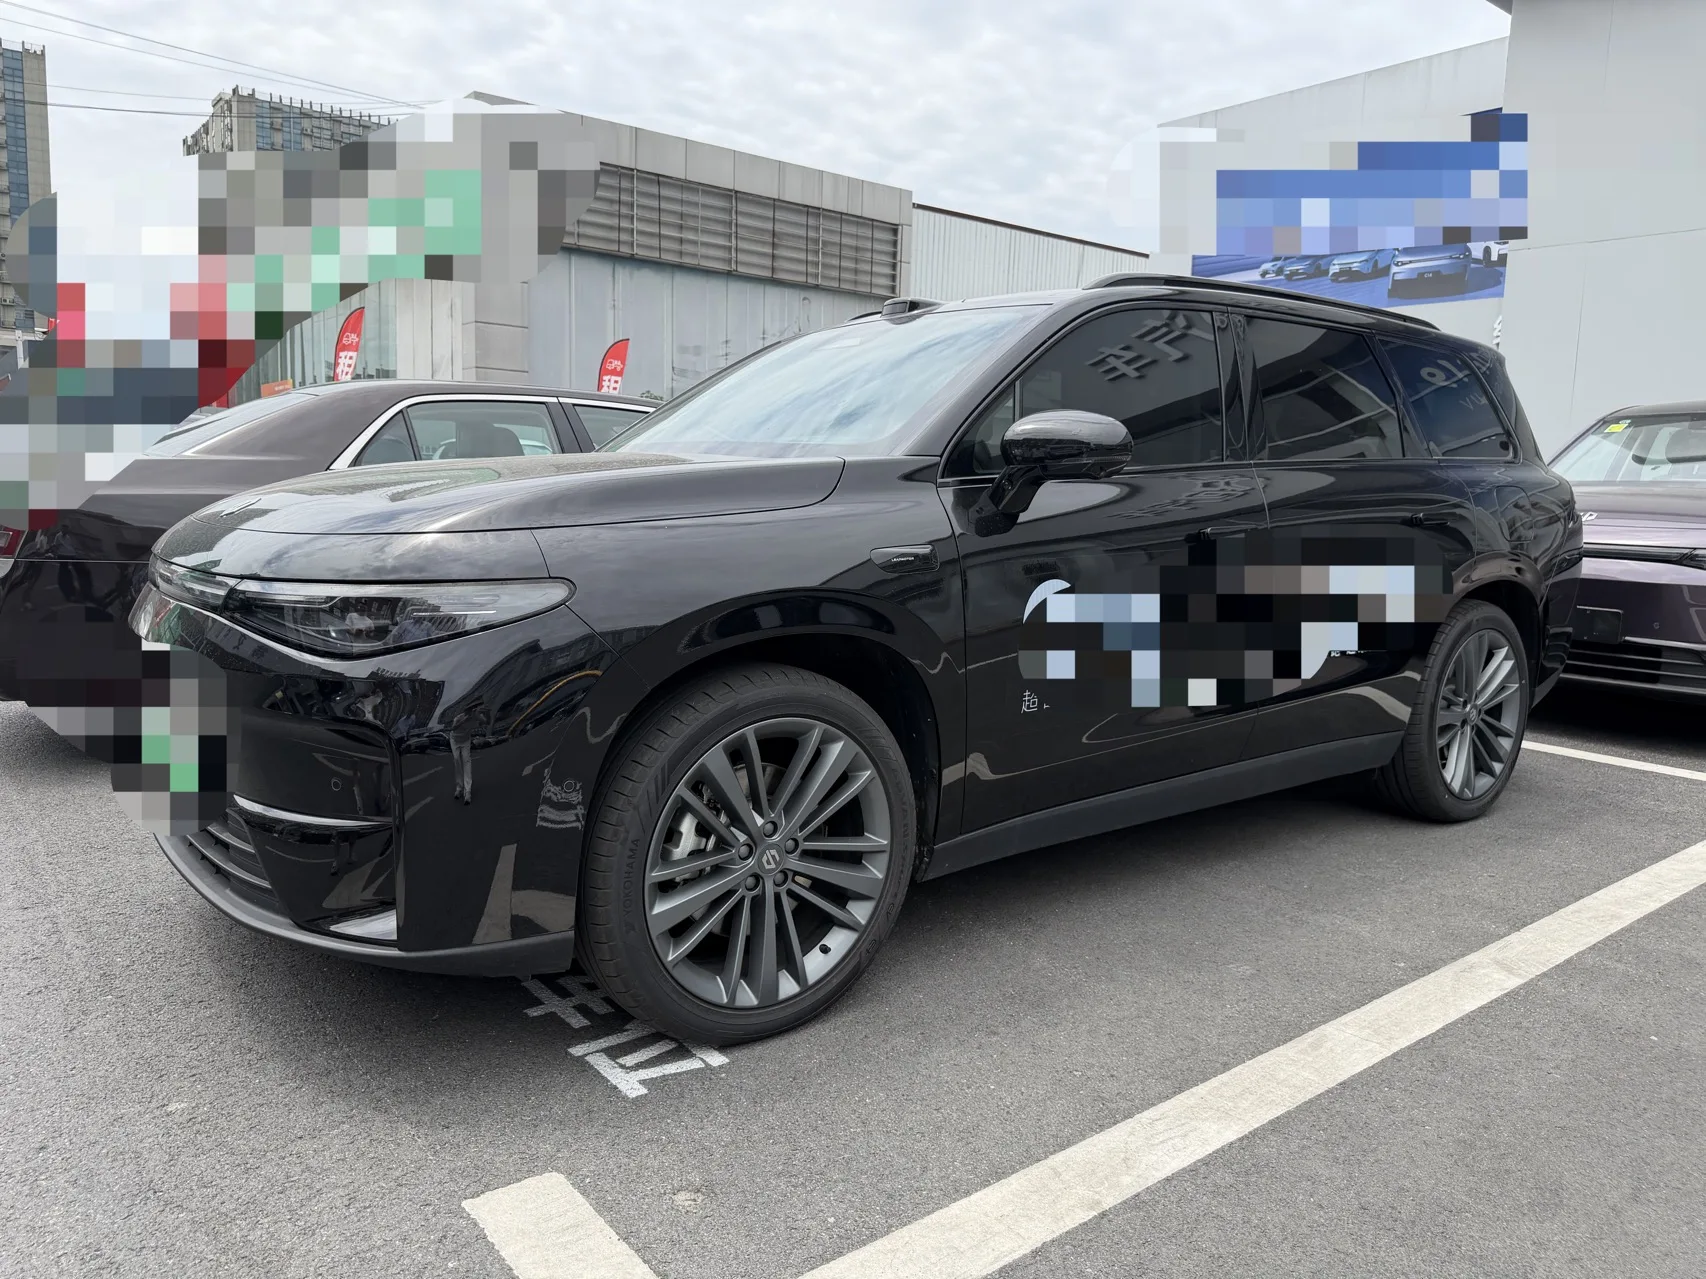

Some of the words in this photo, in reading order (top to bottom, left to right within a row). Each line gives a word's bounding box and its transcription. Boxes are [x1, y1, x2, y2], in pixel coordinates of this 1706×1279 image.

[336, 351, 358, 381] 租
[600, 375, 622, 394] 租
[623, 839, 640, 917] YOKOHAMA
